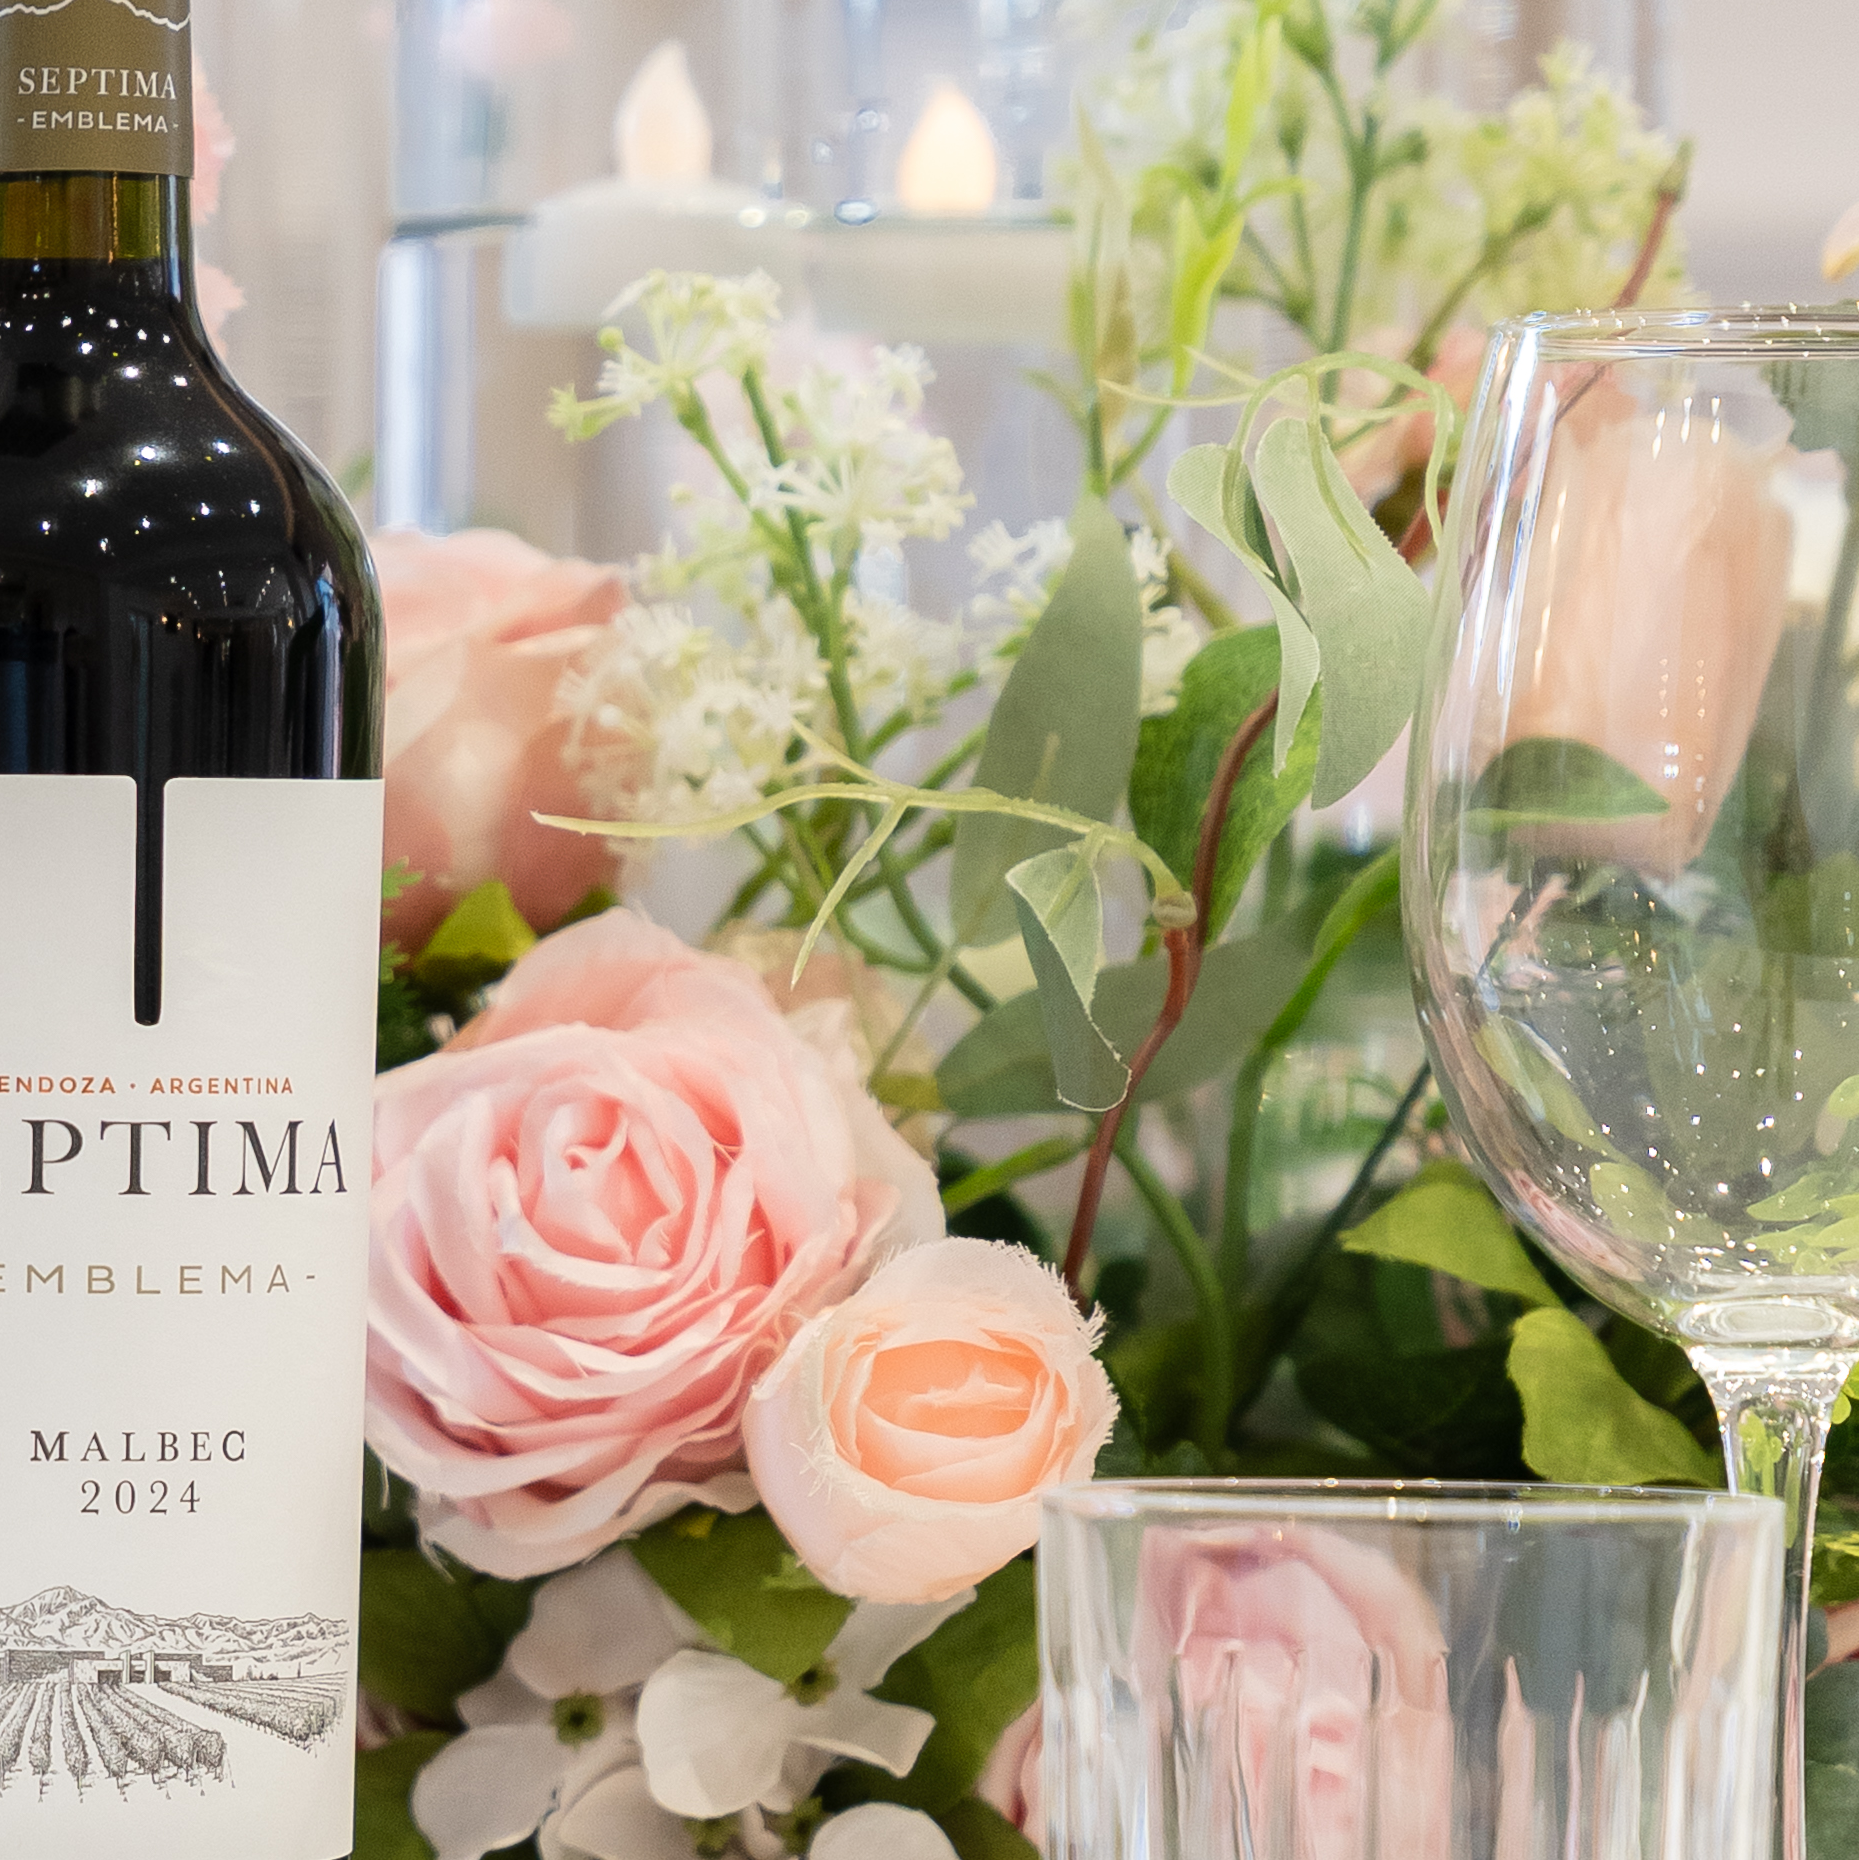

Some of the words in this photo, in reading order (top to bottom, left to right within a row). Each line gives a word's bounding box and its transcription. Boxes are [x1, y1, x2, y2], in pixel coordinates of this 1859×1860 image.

[18, 67, 177, 101] SEPTIMA
[149, 1076, 294, 1095] ARGENTINA
[29, 1429, 246, 1463] MALBEC
[80, 1479, 201, 1515] 2024
